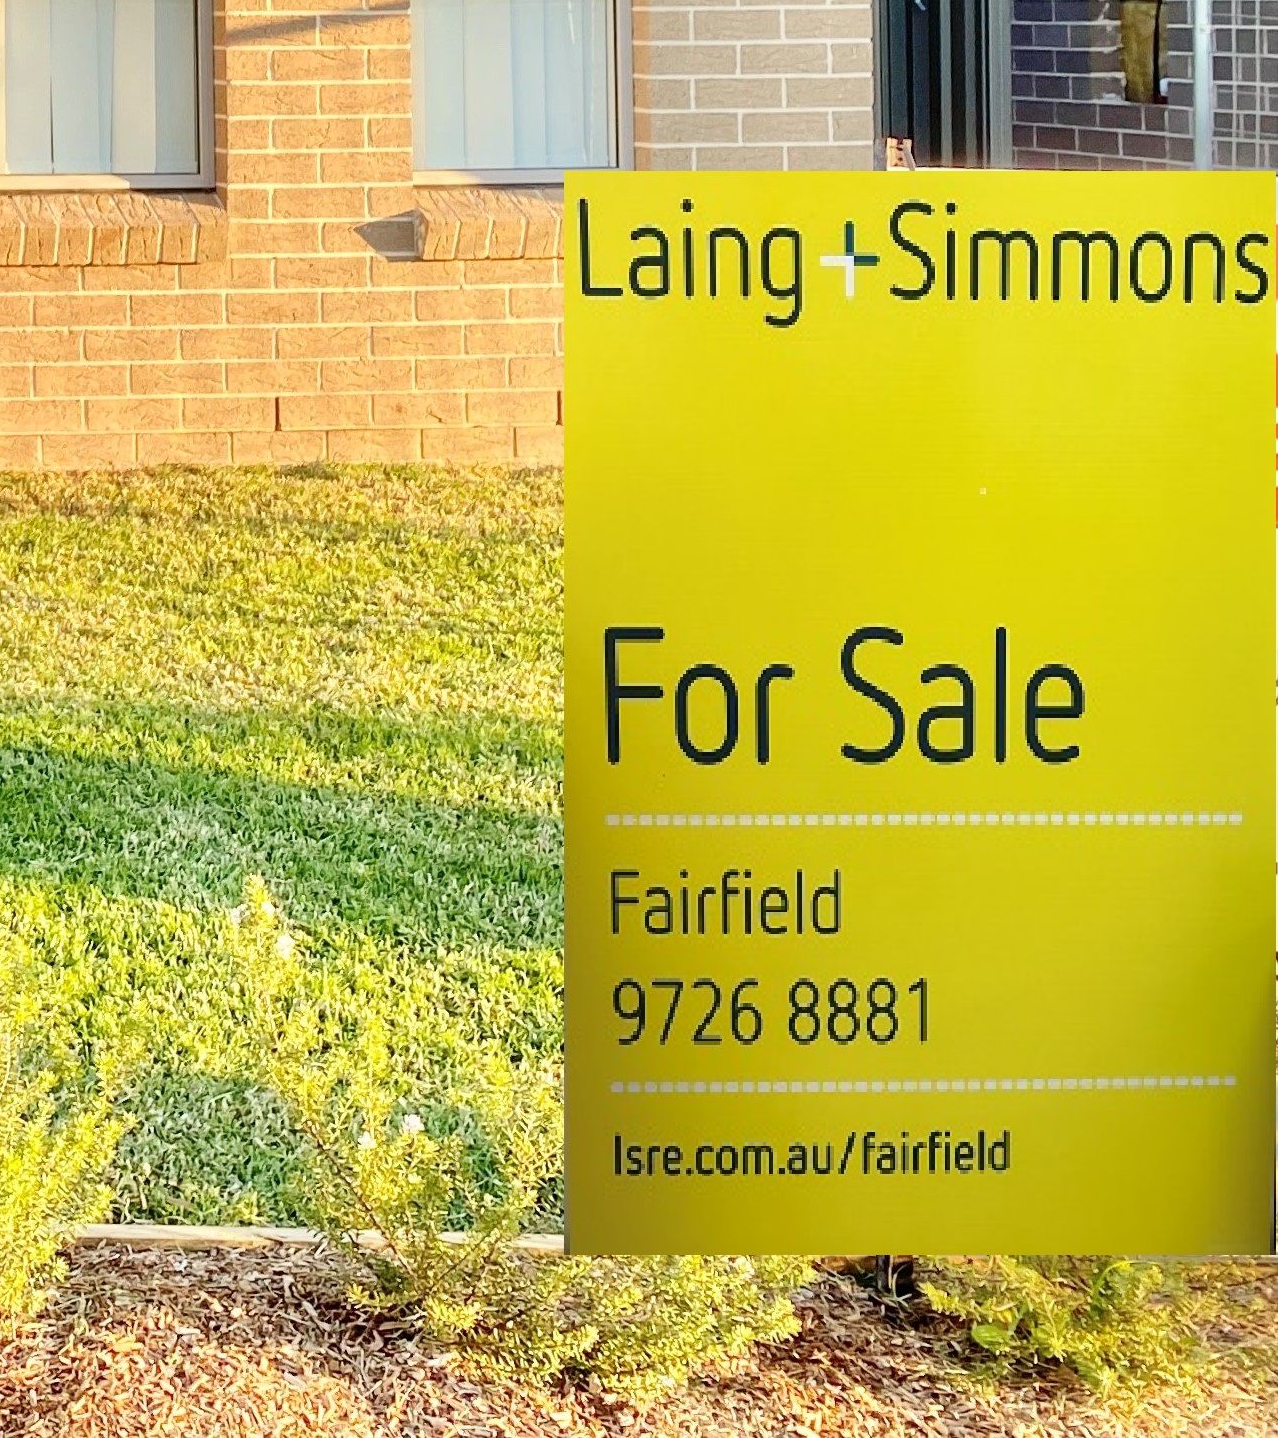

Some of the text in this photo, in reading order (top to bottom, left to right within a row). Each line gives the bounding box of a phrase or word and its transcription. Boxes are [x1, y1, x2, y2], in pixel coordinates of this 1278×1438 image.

[604, 626, 1086, 766] For Sale
[610, 869, 842, 935] Fairfield
[612, 977, 929, 1046] 9726 8881
[614, 1130, 1011, 1177] lsre.com.au/fairfield
